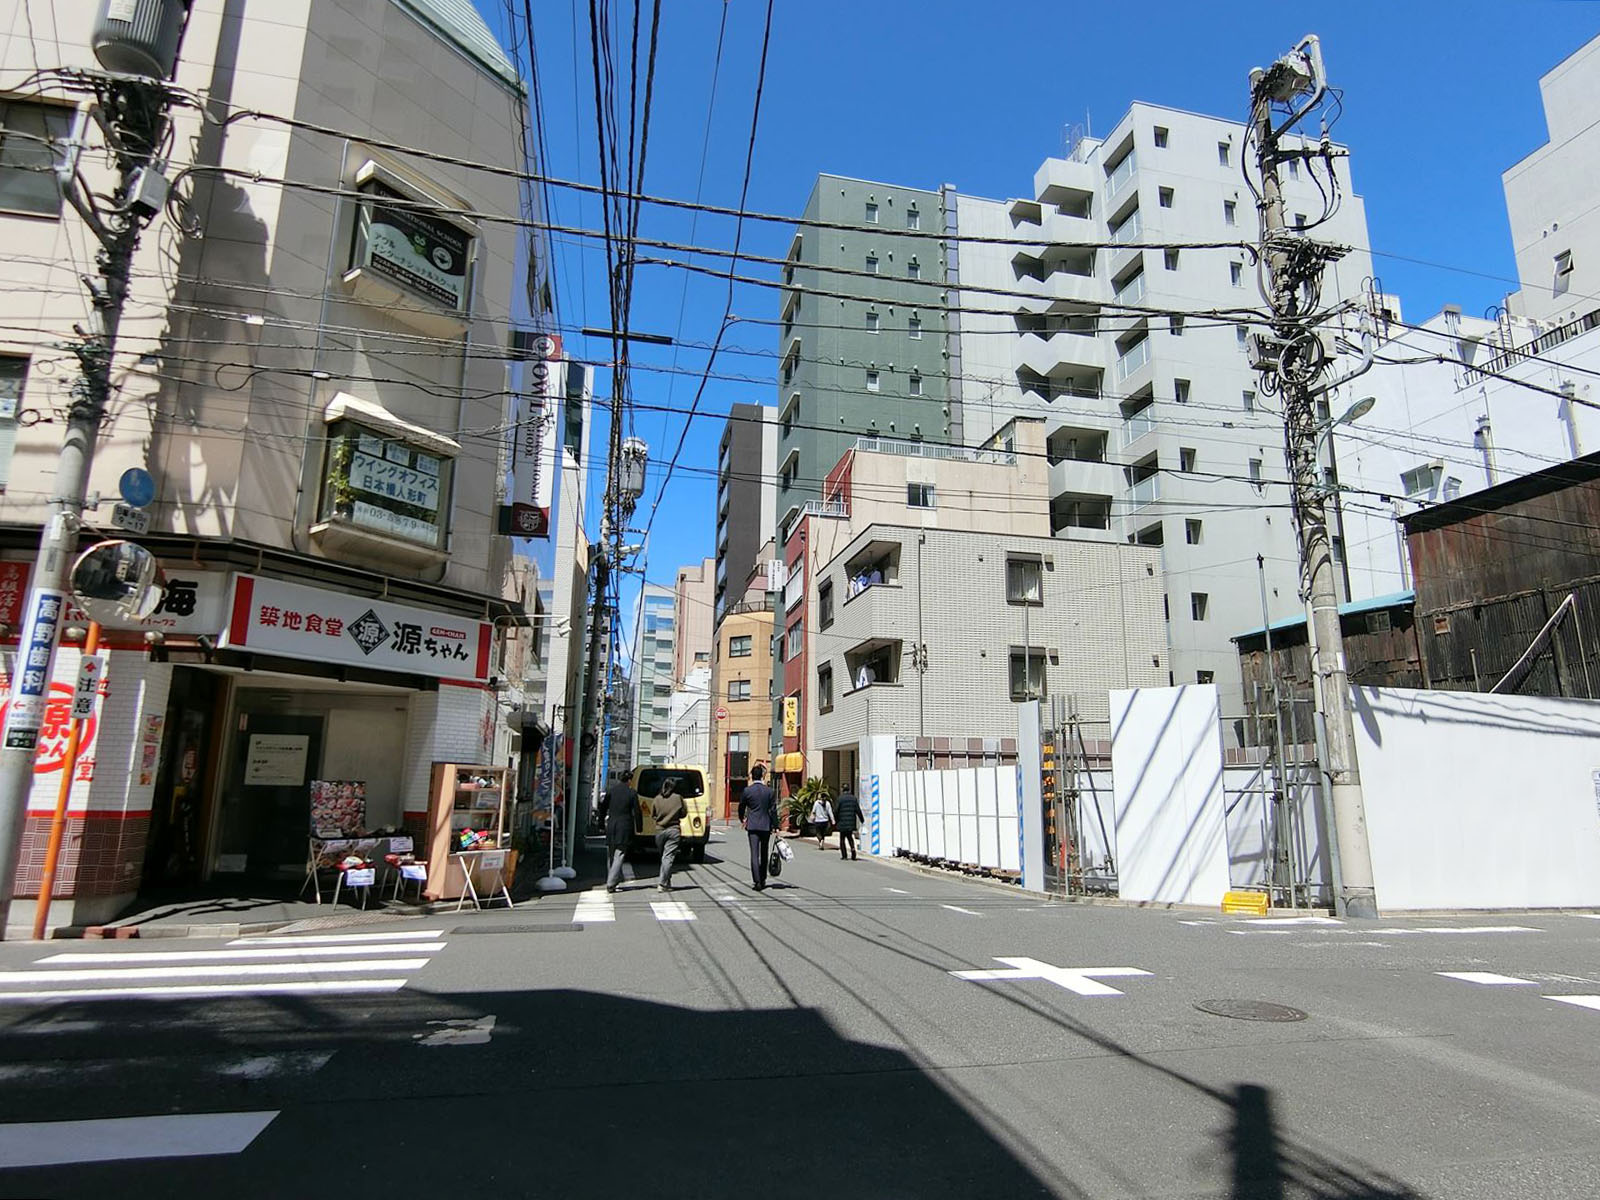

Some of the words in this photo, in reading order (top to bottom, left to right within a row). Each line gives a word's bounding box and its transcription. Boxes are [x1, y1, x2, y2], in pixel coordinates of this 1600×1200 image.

[530, 363, 549, 411] OWL
[354, 455, 438, 491] ウイングオフィス
[259, 605, 345, 637] 築地食堂
[357, 619, 380, 645] 源
[23, 598, 60, 693] 高野歯科
[390, 620, 470, 662] 源ちゃん
[74, 677, 97, 714] 注意
